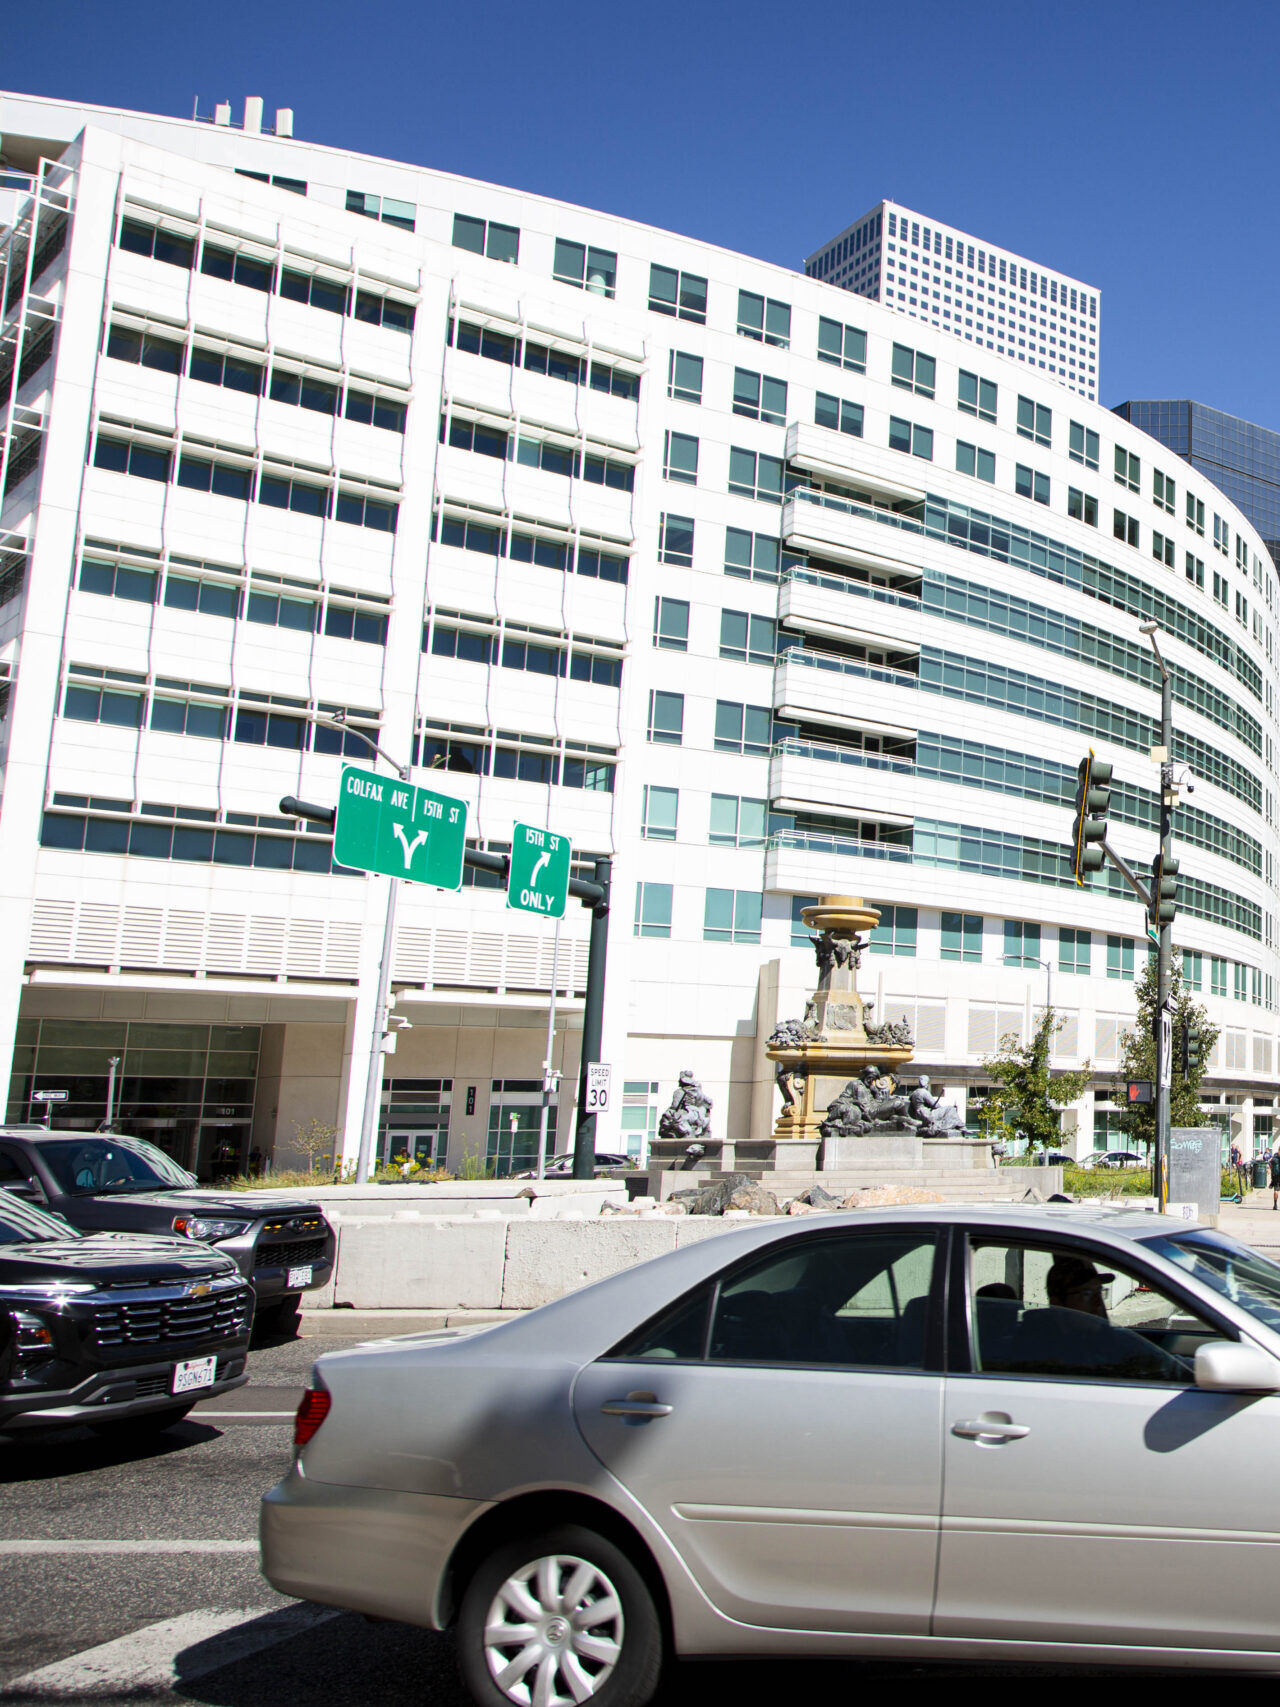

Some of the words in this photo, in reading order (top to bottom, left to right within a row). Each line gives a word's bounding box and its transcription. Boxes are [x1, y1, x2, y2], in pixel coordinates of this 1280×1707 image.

[346, 776, 384, 803] COLFAX
[390, 789, 410, 810] AVE
[423, 799, 444, 820] 15TH
[448, 807, 461, 824] ST
[525, 828, 545, 848] 15TH
[549, 836, 561, 852] ST
[519, 888, 556, 912] ONLY
[590, 1068, 609, 1077] SPEED
[591, 1078, 607, 1087] LIMIT
[589, 1088, 608, 1107] 30
